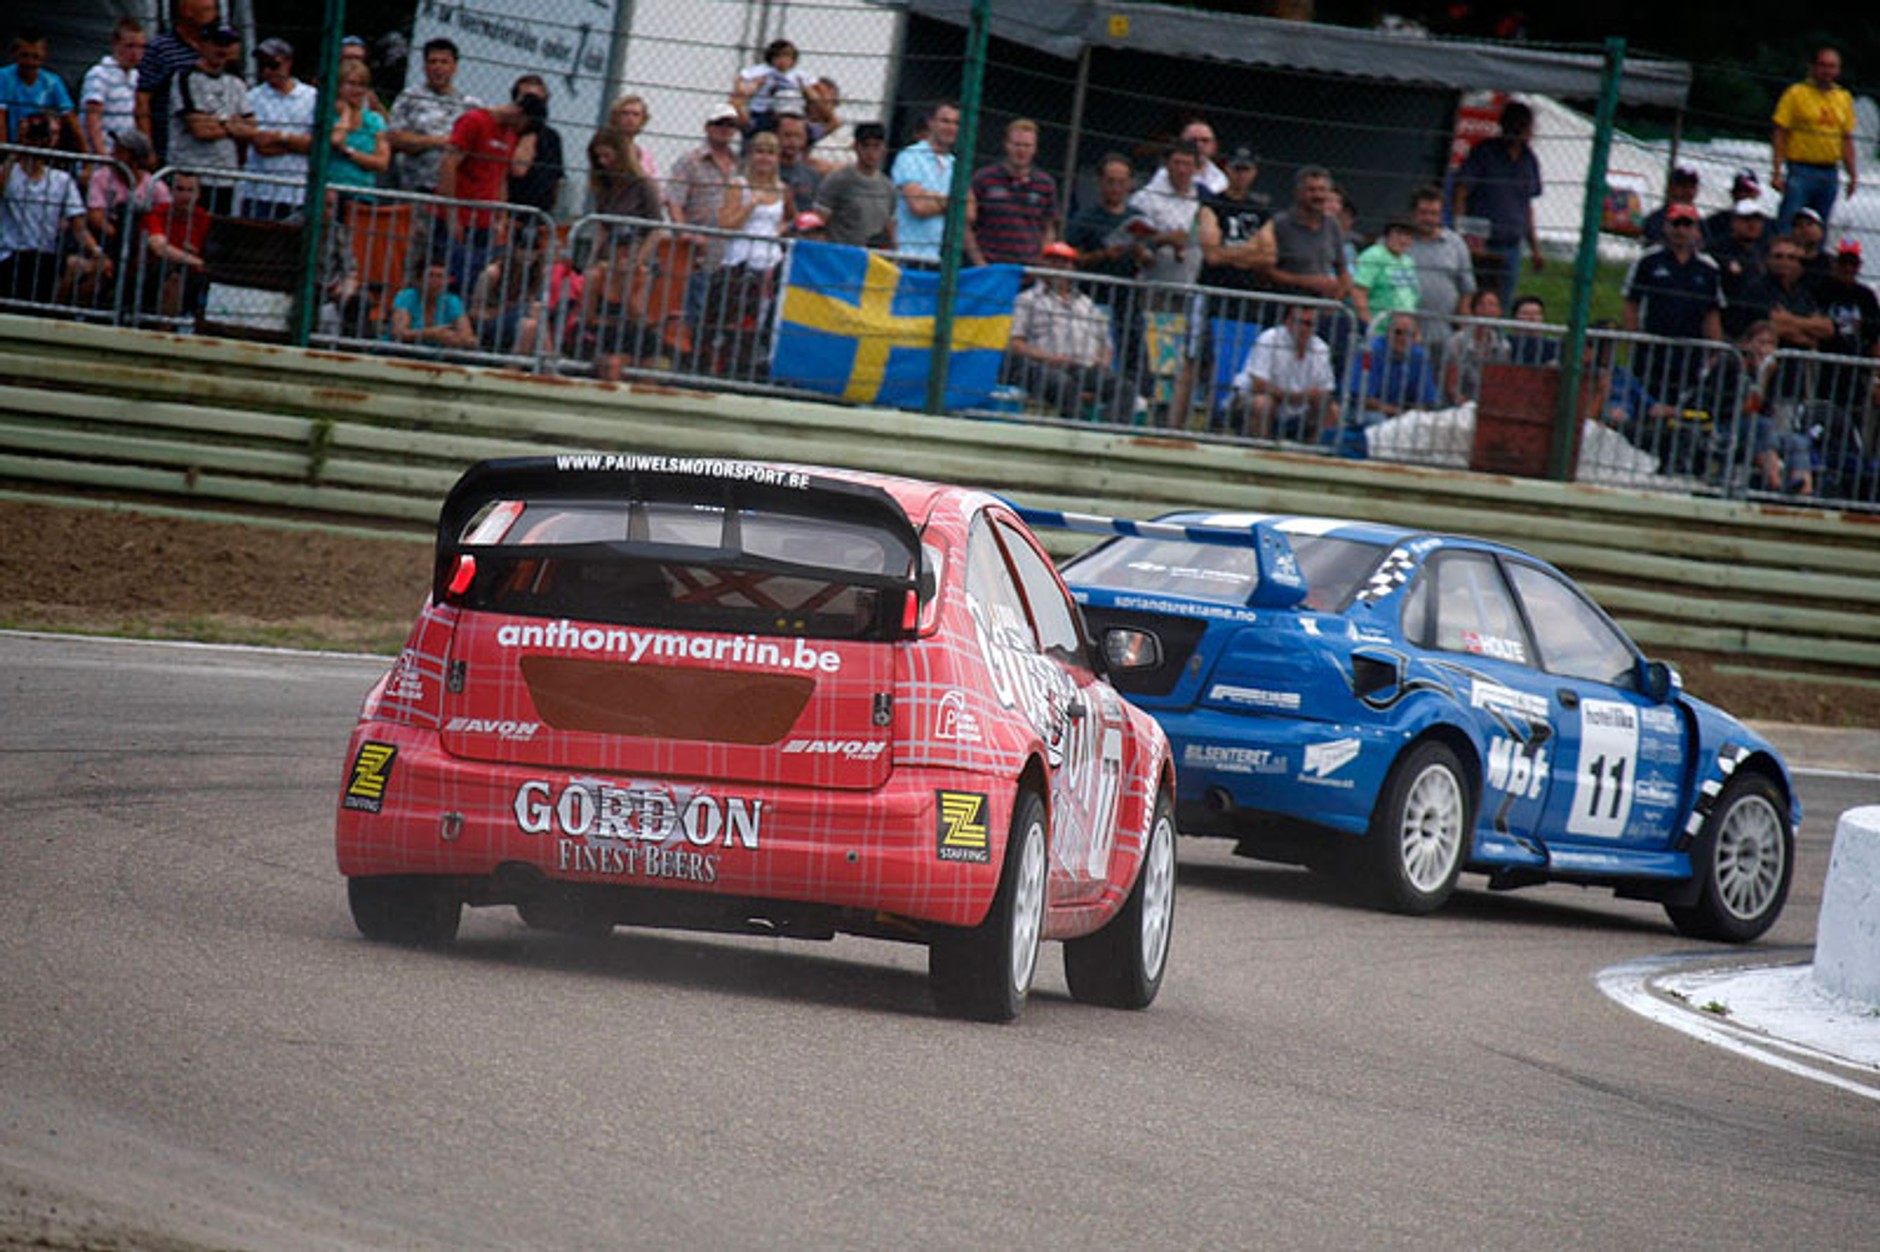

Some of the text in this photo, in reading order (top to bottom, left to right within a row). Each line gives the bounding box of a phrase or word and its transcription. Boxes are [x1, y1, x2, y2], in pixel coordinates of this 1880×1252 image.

[556, 454, 810, 490] WWW.PAUWELSMOTORSPORT.BE
[497, 619, 841, 672] anthonymartin.be
[465, 719, 540, 735] AVON
[805, 740, 887, 754] AVON
[1588, 754, 1626, 819] 11
[514, 780, 763, 849] GORDON
[559, 839, 718, 883] FINEST BEERS
